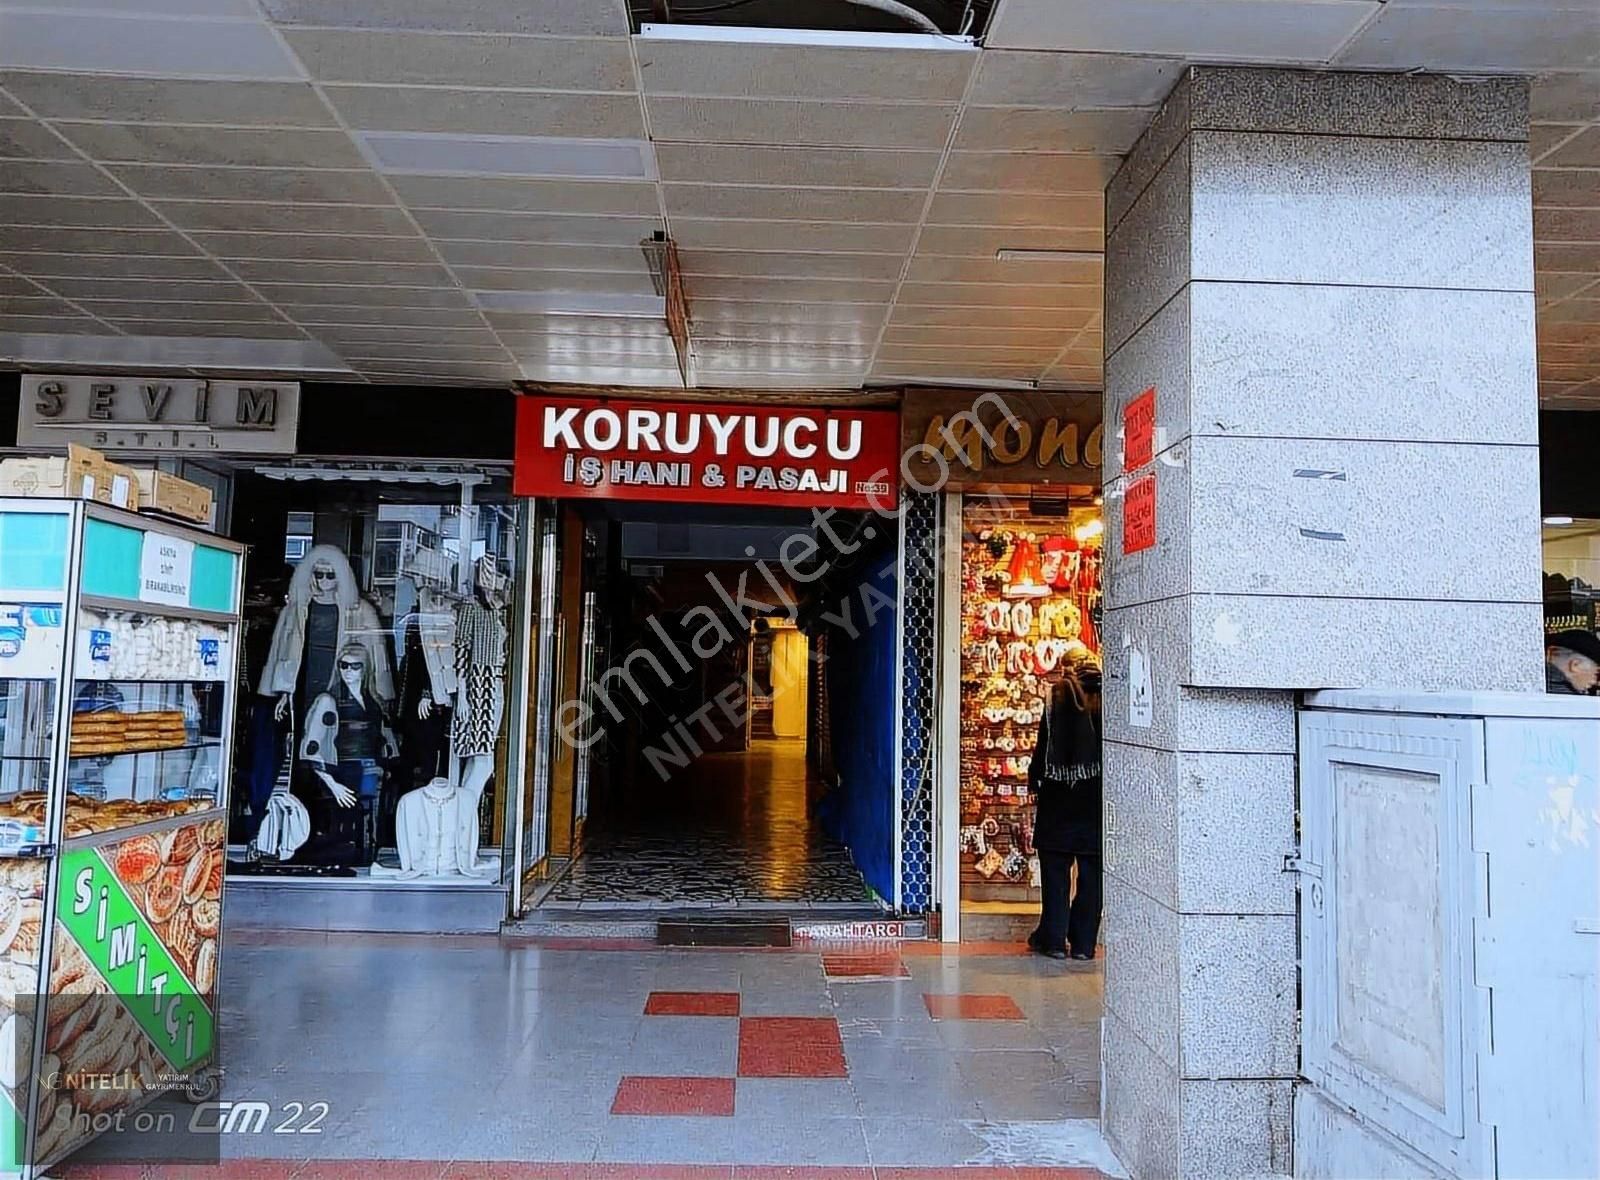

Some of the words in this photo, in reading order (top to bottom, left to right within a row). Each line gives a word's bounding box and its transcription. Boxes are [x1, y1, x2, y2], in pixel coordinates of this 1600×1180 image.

[542, 406, 863, 461] KORUYUCU
[564, 453, 603, 487] İŞ
[610, 459, 691, 486] HANI
[702, 463, 726, 487] &
[736, 466, 848, 493] PASAJI
[73, 867, 195, 1060] SİMİTÇİ
